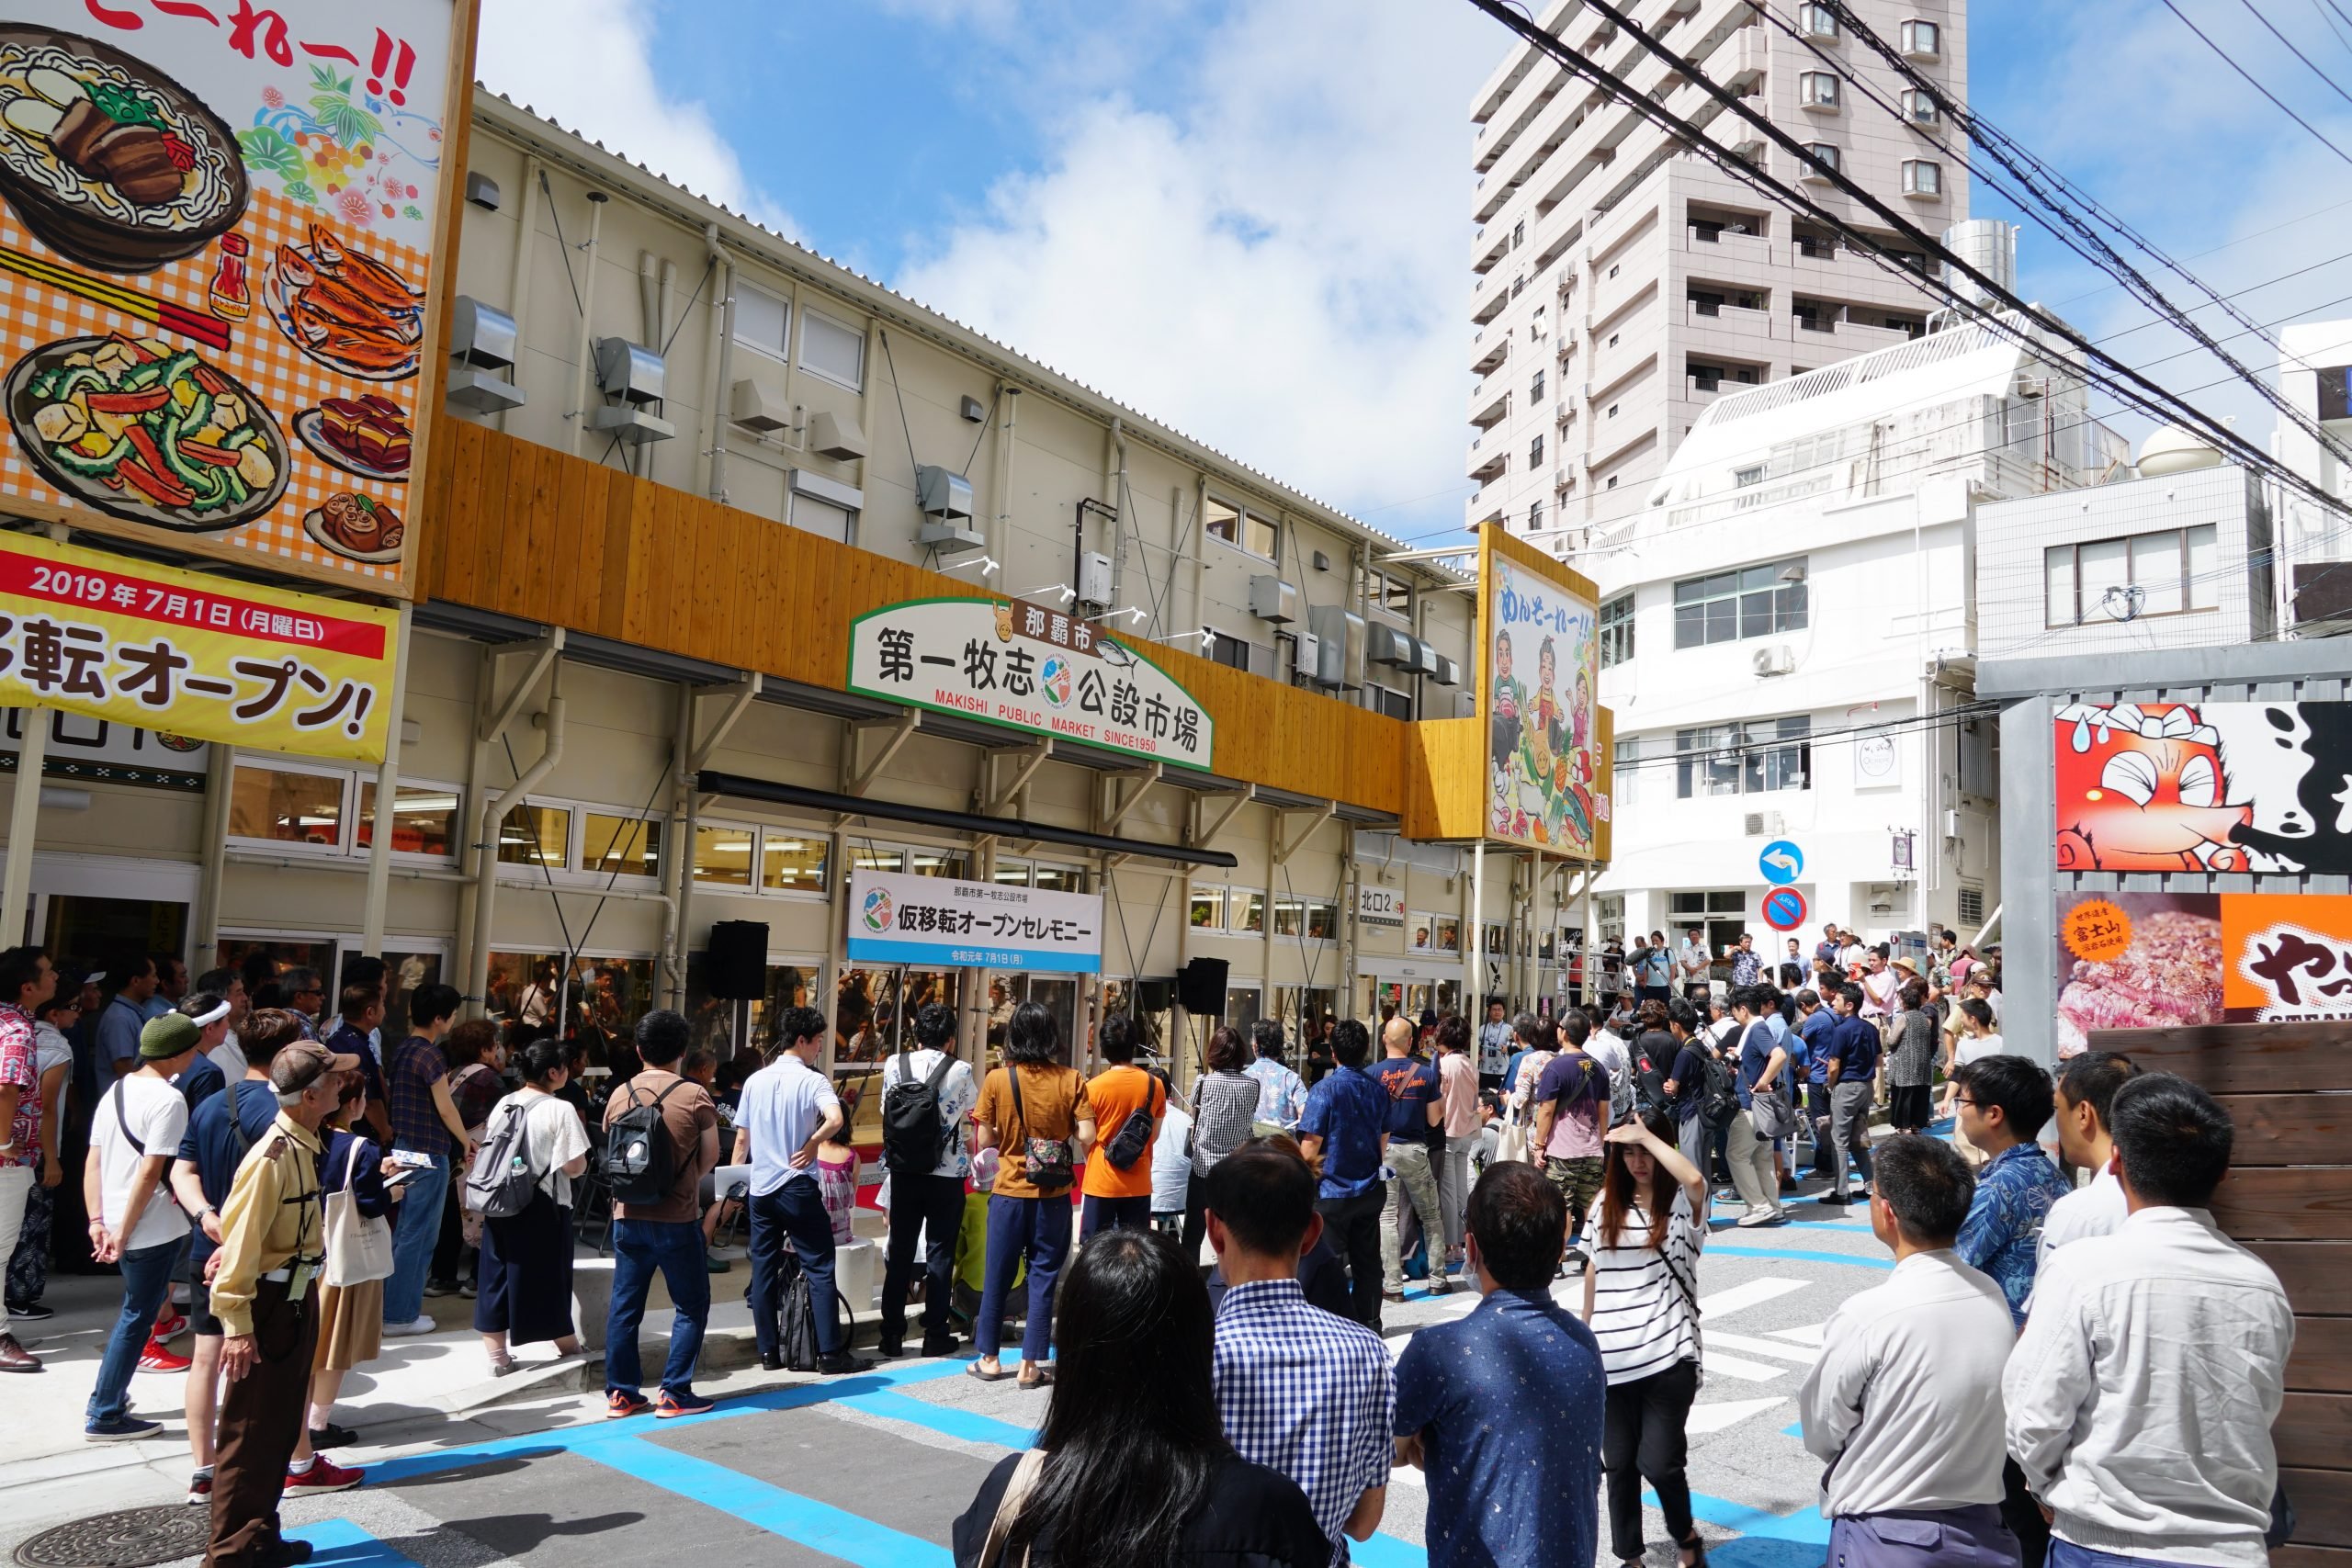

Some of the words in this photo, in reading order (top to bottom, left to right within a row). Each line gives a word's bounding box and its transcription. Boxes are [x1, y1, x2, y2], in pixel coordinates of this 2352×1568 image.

[1025, 605, 1091, 650] 那覇市
[1500, 585, 1589, 640] めんそーれー!!
[0, 616, 373, 736] 転オープン!
[934, 688, 988, 715] MAKISHI
[998, 704, 1042, 728] PUBLIC
[1051, 716, 1095, 739] MARKET
[1104, 728, 1156, 753] SINCE1950
[954, 886, 1028, 904] 那覇市第一牧志公設市場
[1361, 889, 1391, 912] 北口2
[898, 903, 1091, 942] 仮移転オープンセレモニー
[2073, 919, 2120, 942] 富士山
[2081, 935, 2124, 953] 溶岩石使用
